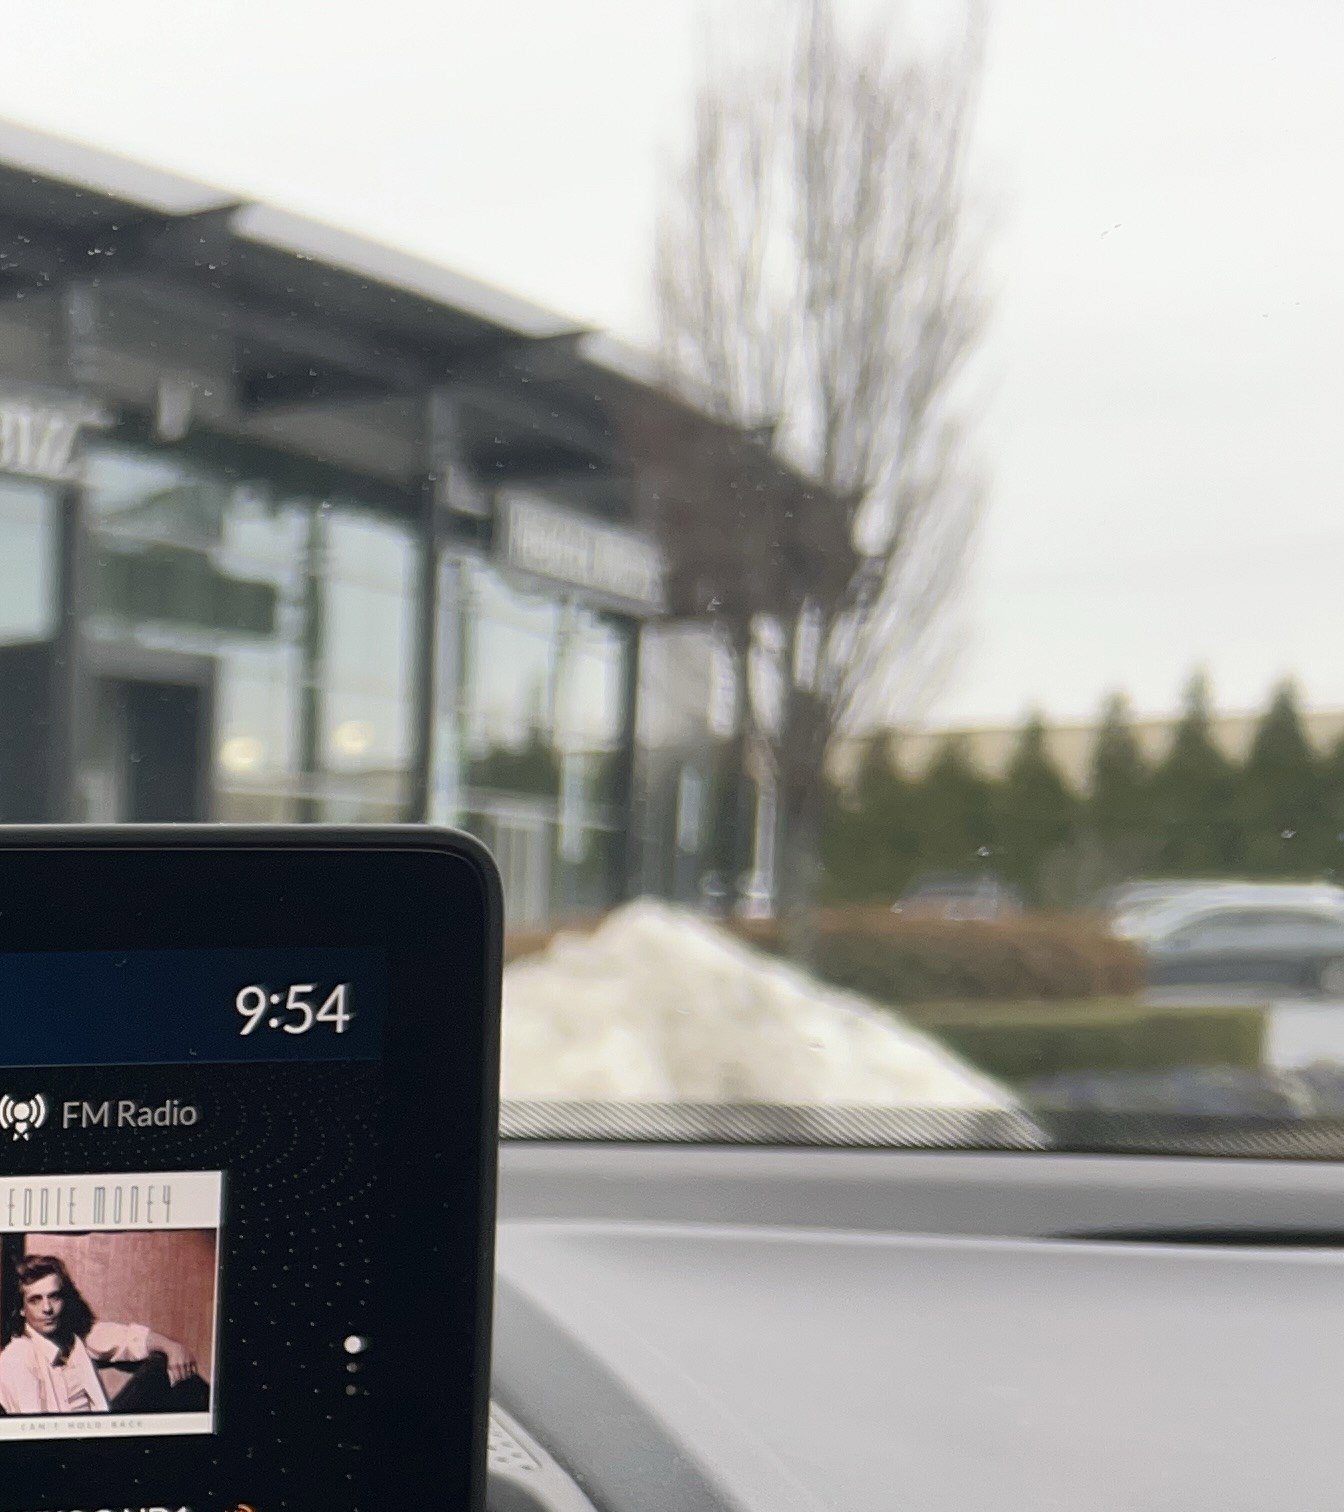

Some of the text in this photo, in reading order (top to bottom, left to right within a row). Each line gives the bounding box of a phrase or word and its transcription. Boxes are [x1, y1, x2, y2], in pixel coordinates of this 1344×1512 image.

[235, 983, 352, 1035] 9:54
[61, 1098, 198, 1129] FM Radio
[7, 1184, 172, 1227] EDDIE MONEY
